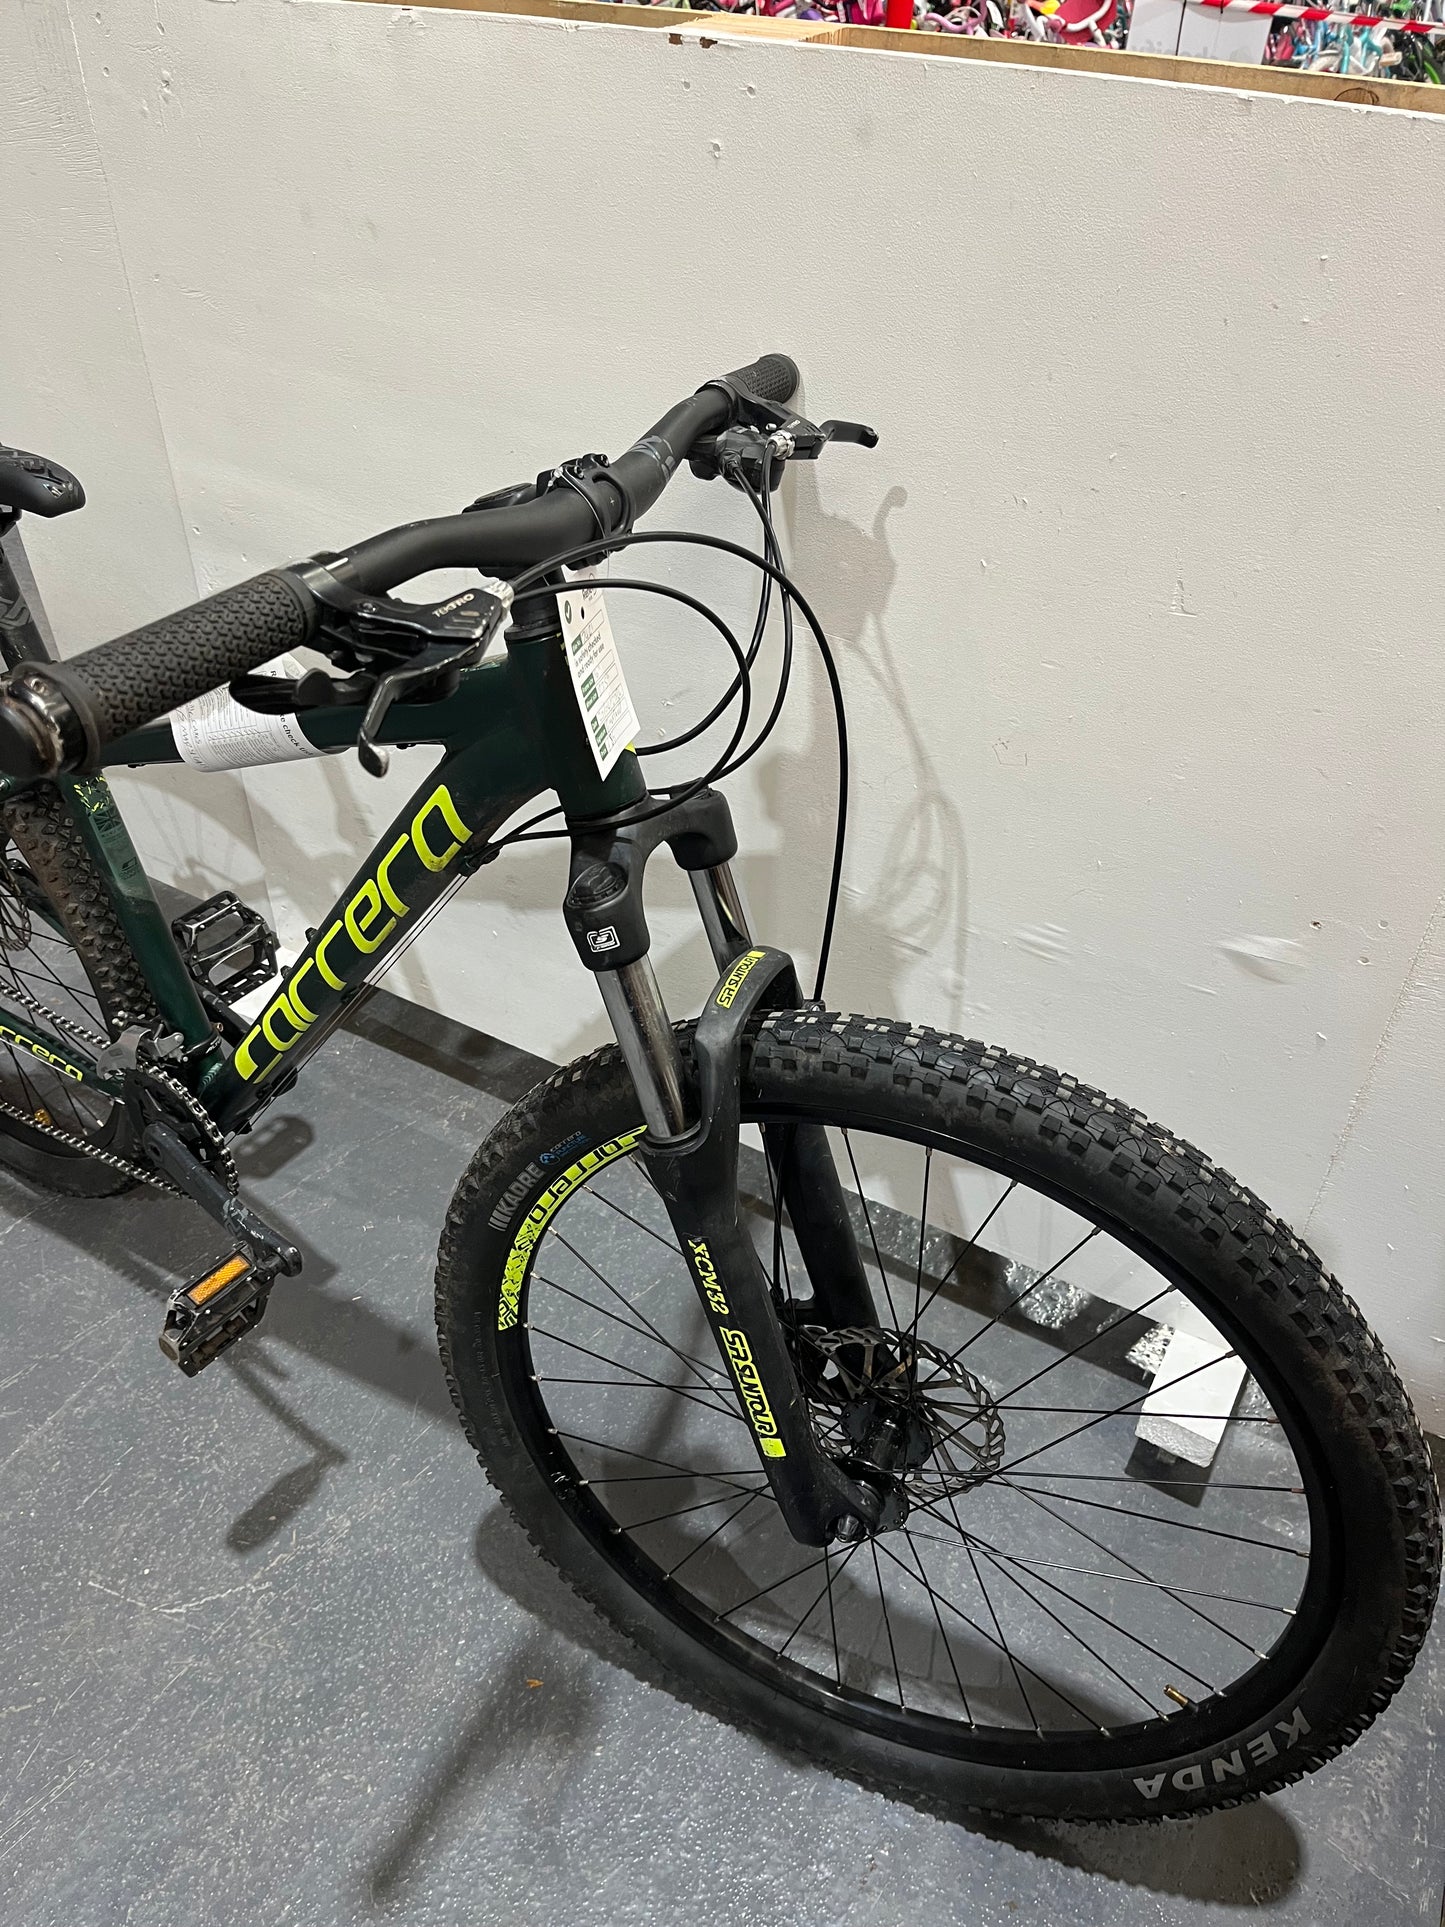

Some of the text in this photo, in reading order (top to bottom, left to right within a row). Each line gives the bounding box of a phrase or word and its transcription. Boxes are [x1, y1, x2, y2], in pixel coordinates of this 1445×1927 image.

[432, 593, 475, 617] TEKTRO
[282, 724, 300, 747] check
[234, 784, 473, 1083] carrera
[717, 956, 757, 1007] SR SUNTOUR
[496, 1162, 546, 1216] KADRE
[687, 1239, 730, 1316] XCM32
[722, 1329, 777, 1436] SR SUNTOUR
[1133, 1706, 1312, 1799] KENDA
